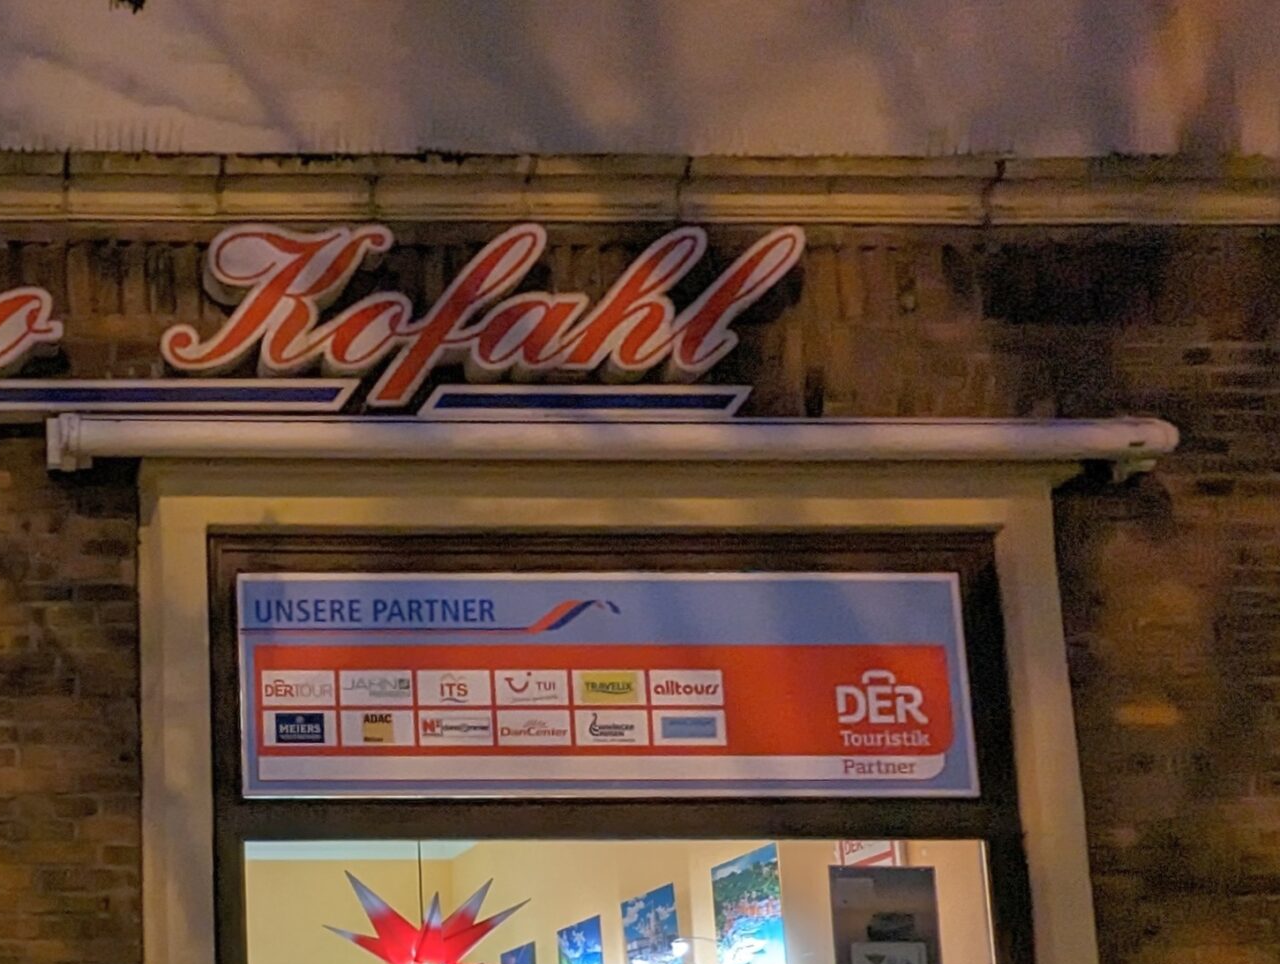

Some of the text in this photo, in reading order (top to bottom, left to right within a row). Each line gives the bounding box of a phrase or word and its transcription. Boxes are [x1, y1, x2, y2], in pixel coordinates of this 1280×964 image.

[162, 223, 805, 408] Kofahl
[254, 599, 496, 623] UNSERE PARTNER
[440, 682, 468, 697] ITS
[536, 681, 556, 691] TUI
[653, 680, 720, 696] alltours
[835, 684, 929, 725] DER
[363, 713, 393, 724] ADAC
[278, 723, 322, 734] MEIERS
[839, 730, 931, 747] Touristik
[842, 758, 917, 774] Partner
